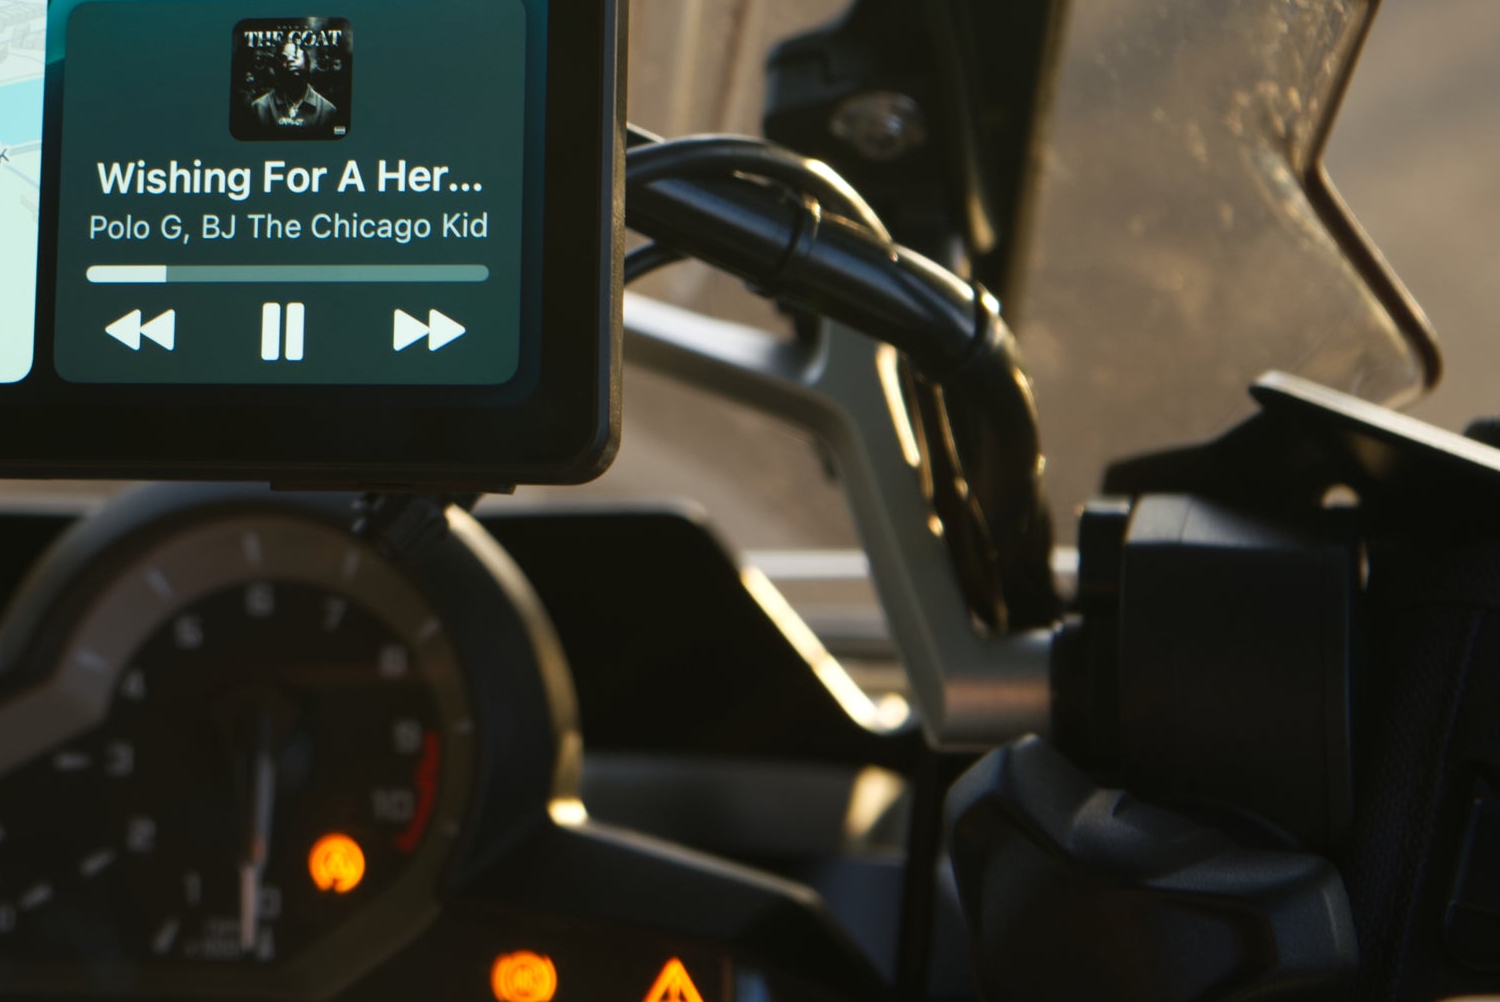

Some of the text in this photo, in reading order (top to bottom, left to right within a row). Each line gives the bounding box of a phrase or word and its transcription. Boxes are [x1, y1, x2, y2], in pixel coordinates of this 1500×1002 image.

[244, 29, 342, 47] THE GOAT
[97, 159, 482, 201] Wishing For A Her...
[90, 211, 488, 245] Polo G, BJ The Chicago Kid
